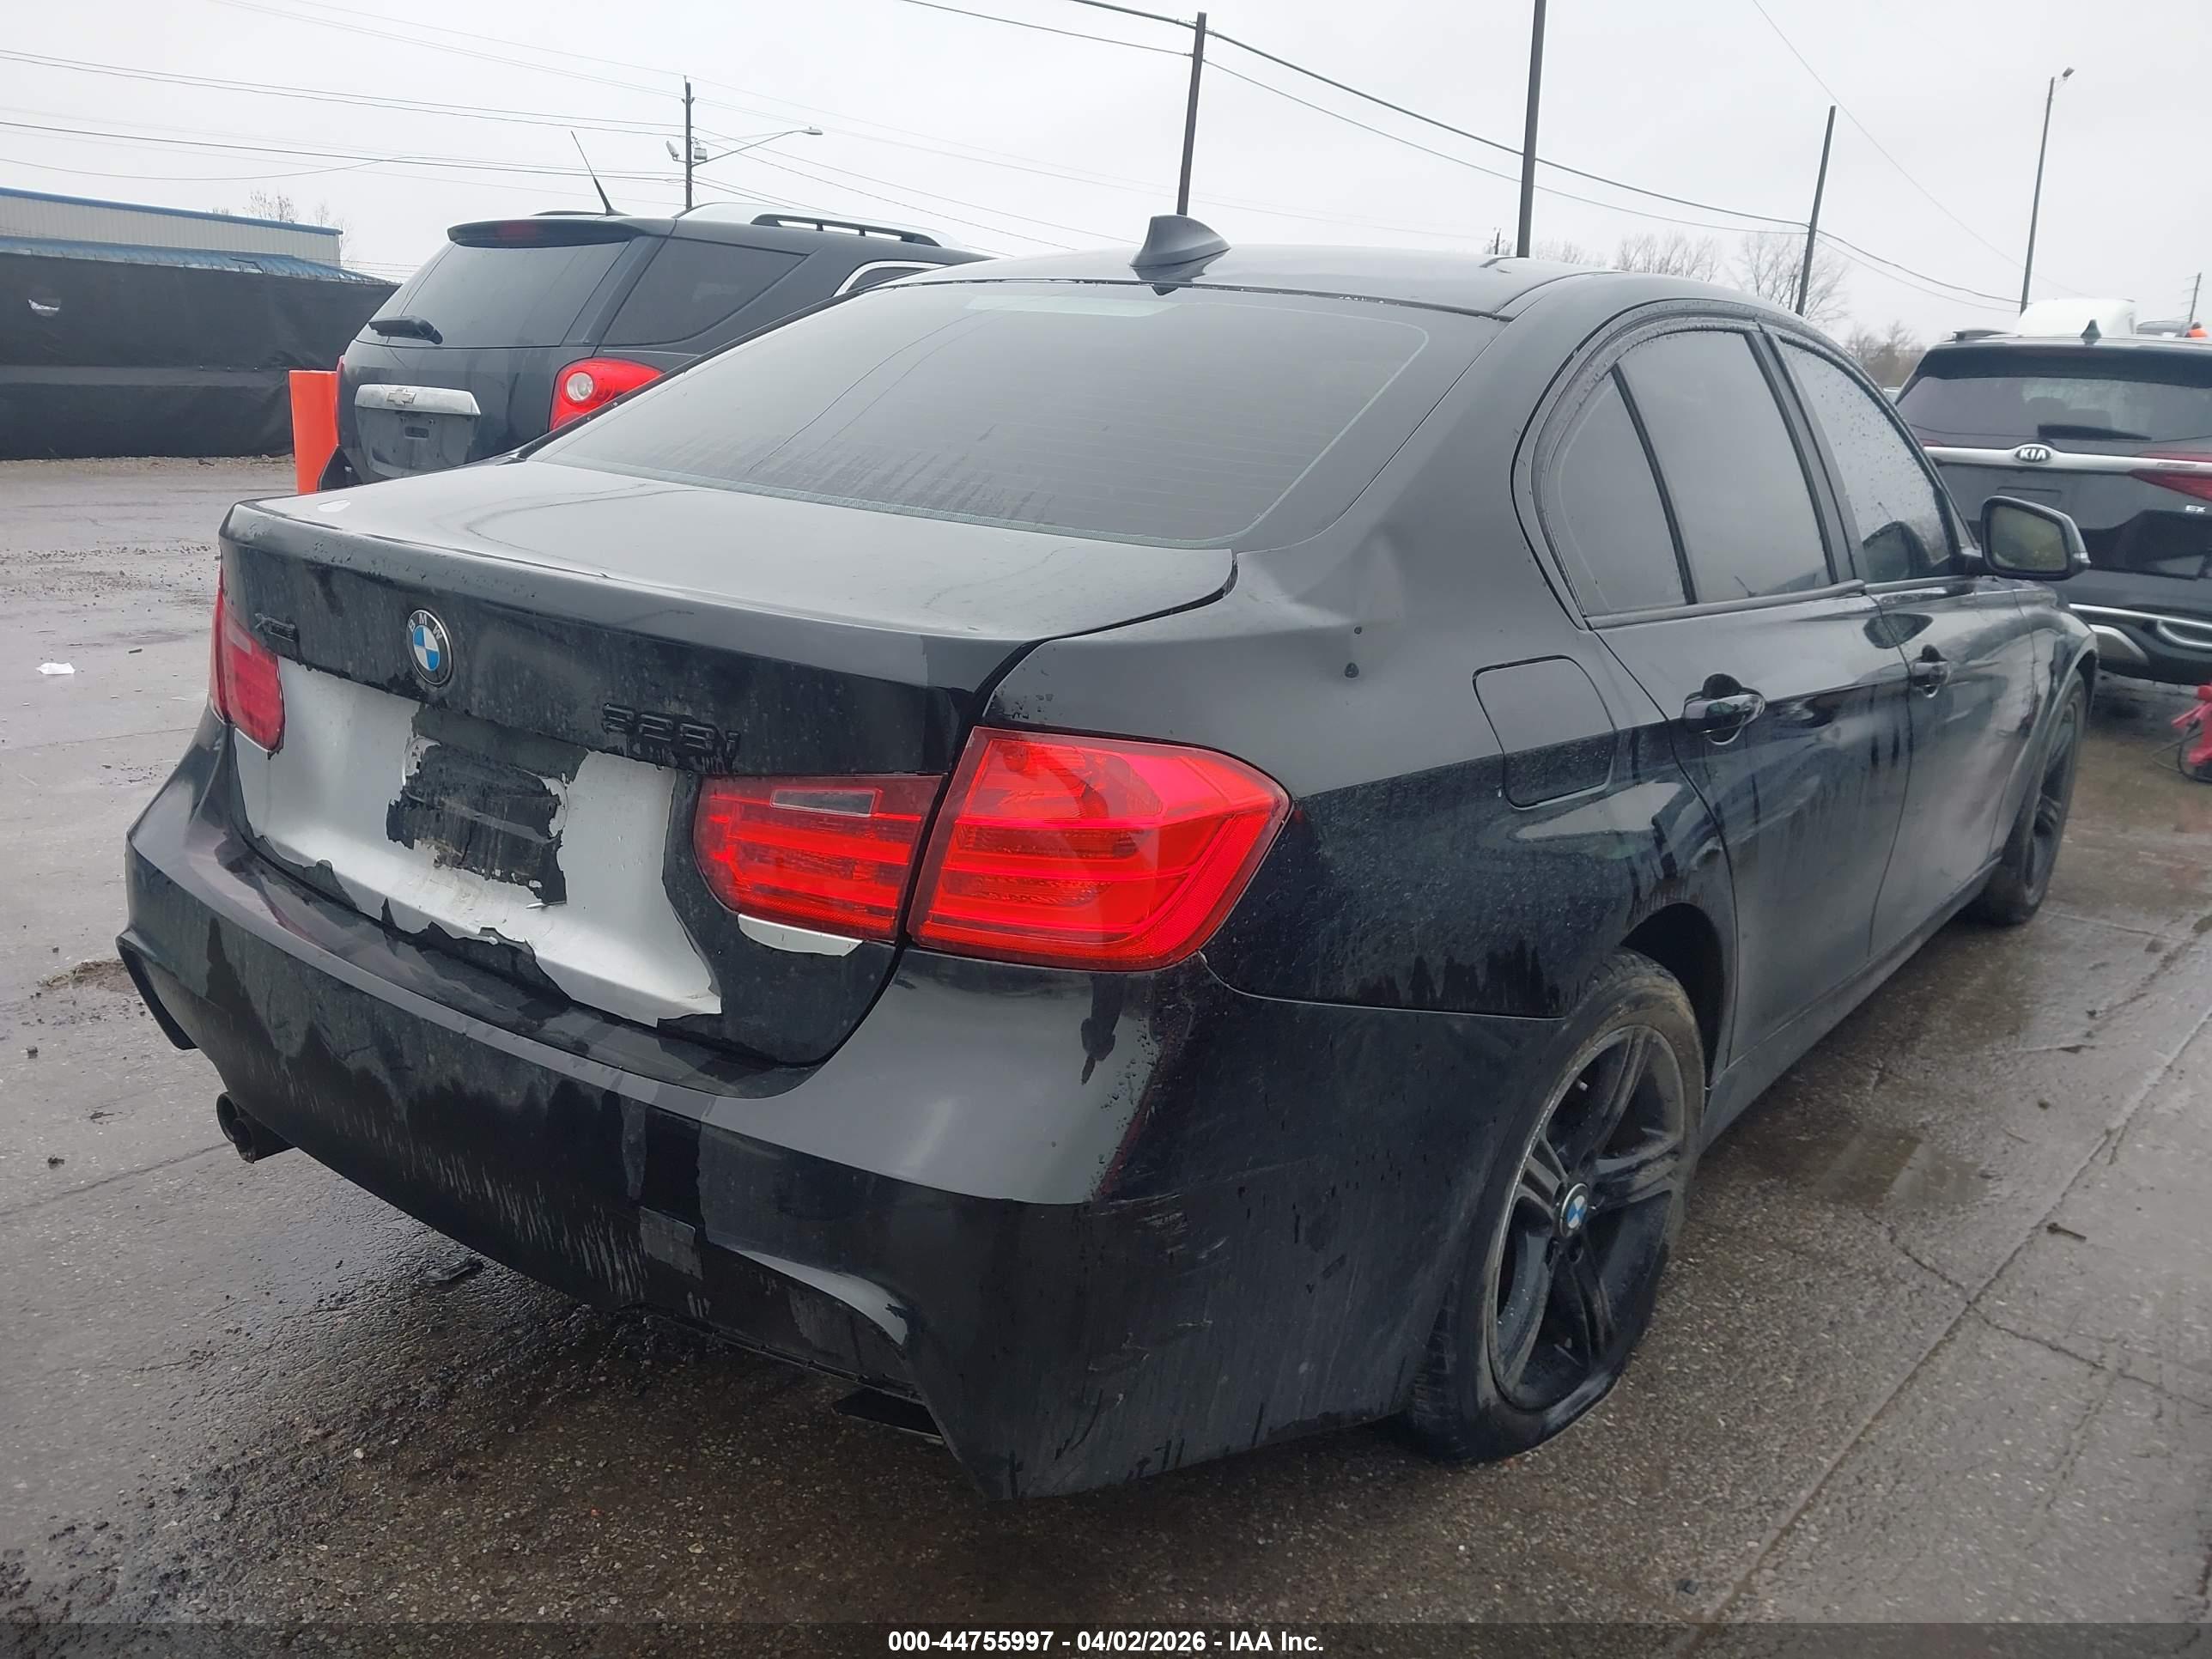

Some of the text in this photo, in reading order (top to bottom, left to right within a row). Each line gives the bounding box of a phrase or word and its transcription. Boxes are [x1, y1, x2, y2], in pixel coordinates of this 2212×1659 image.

[2019, 447, 2047, 461] KIA
[2185, 505, 2206, 514] EX
[408, 612, 443, 641] BMW
[602, 705, 740, 756] 328i
